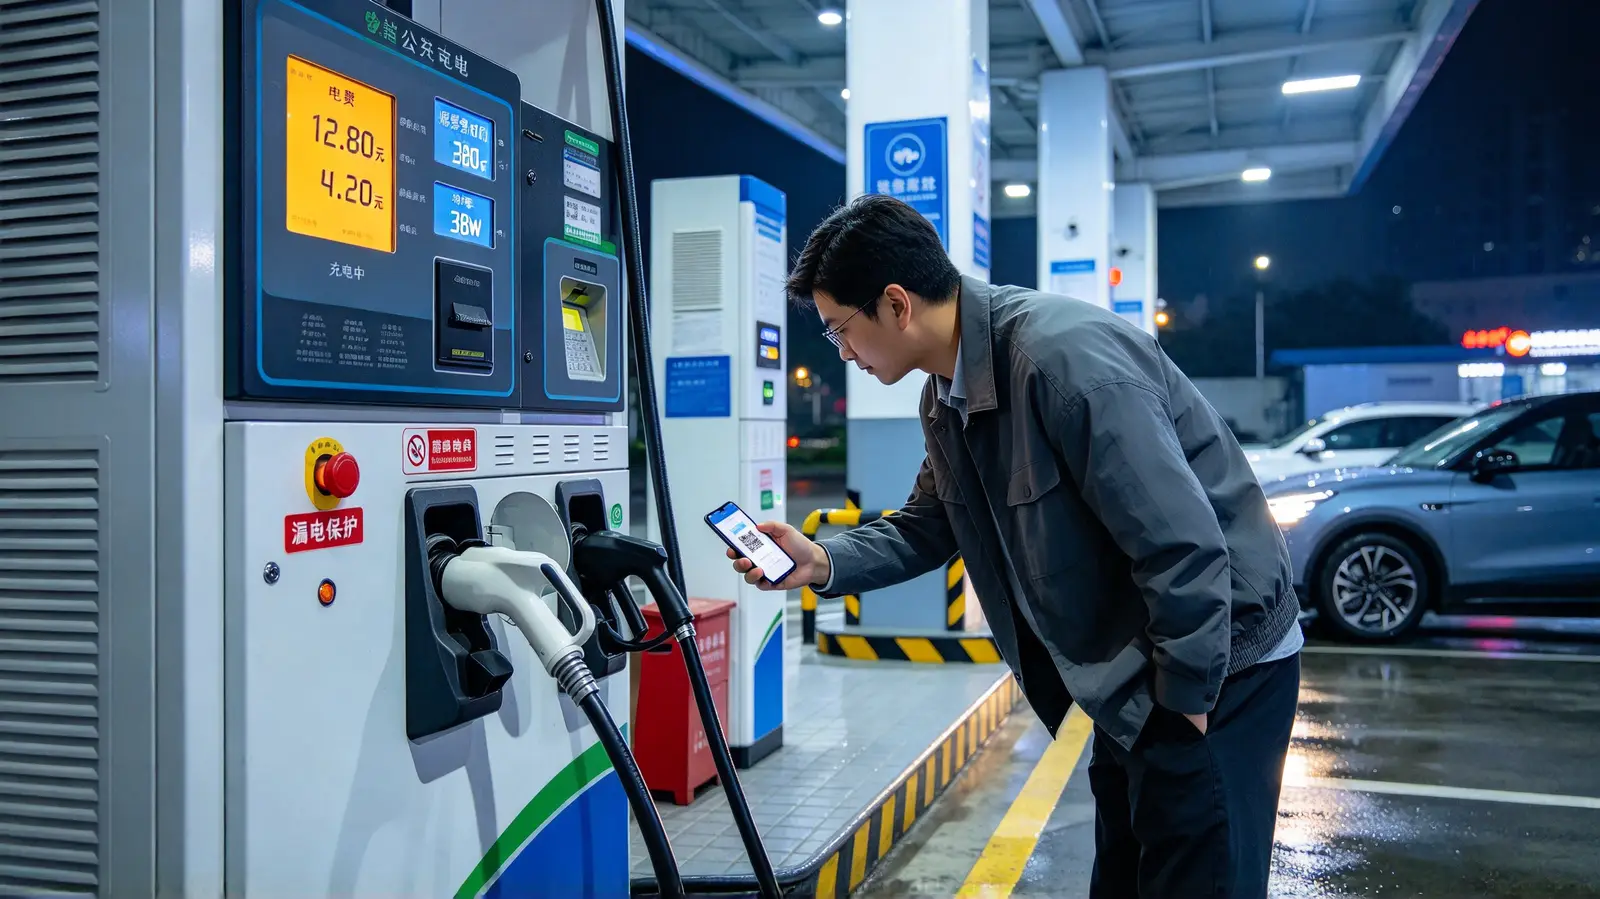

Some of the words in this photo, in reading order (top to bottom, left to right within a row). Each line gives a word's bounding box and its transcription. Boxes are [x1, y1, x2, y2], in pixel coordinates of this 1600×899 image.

[320, 168, 384, 210] 4.20元
[329, 261, 365, 281] 充电中
[291, 515, 358, 545] 漏电保护
